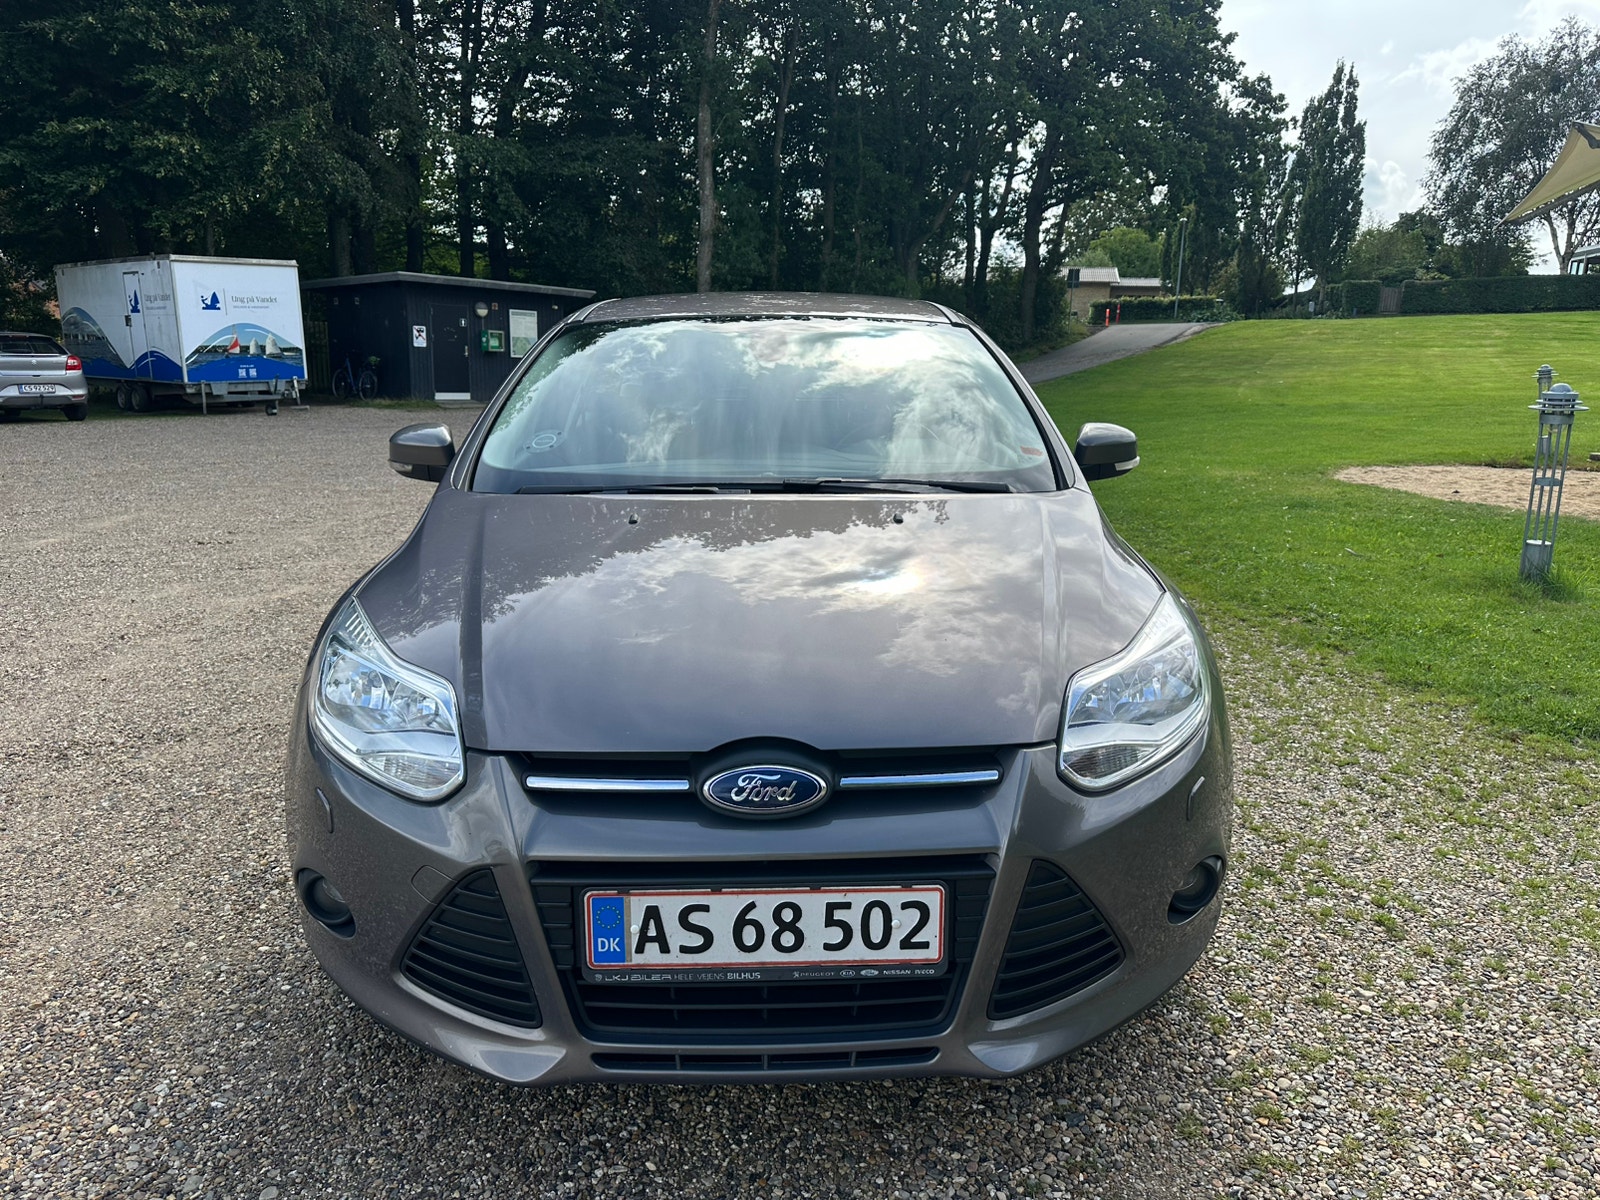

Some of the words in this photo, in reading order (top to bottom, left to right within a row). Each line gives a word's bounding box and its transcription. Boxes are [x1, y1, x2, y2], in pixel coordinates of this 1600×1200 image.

[231, 295, 245, 304] Ung
[731, 774, 797, 802] Ford
[634, 903, 714, 954] AS
[732, 900, 805, 953] 68
[823, 900, 930, 952] 502
[597, 937, 621, 952] DK
[674, 973, 694, 981] HELE
[727, 972, 761, 980] BILHUS
